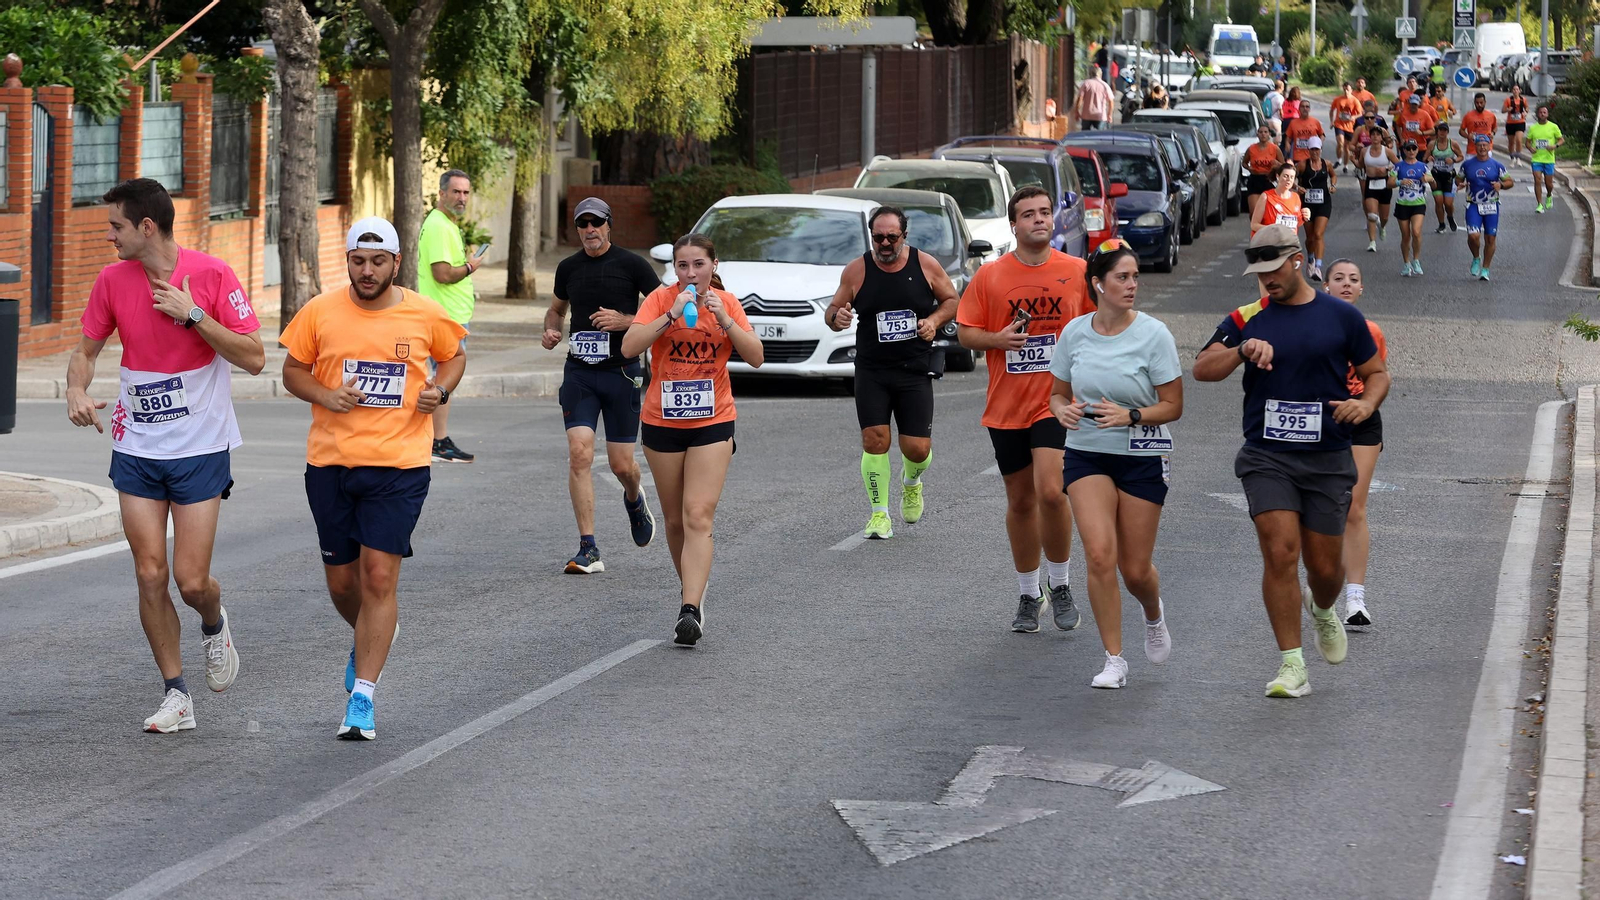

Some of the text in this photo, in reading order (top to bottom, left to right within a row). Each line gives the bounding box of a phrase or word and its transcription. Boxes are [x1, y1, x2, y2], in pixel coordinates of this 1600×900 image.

[760, 326, 783, 338] JSW
[887, 320, 908, 332] 753
[577, 342, 598, 354] 798
[1018, 348, 1045, 361] 902
[358, 375, 391, 393] 777
[140, 394, 172, 411] 880
[674, 393, 701, 407] 839
[1279, 415, 1307, 429] 995
